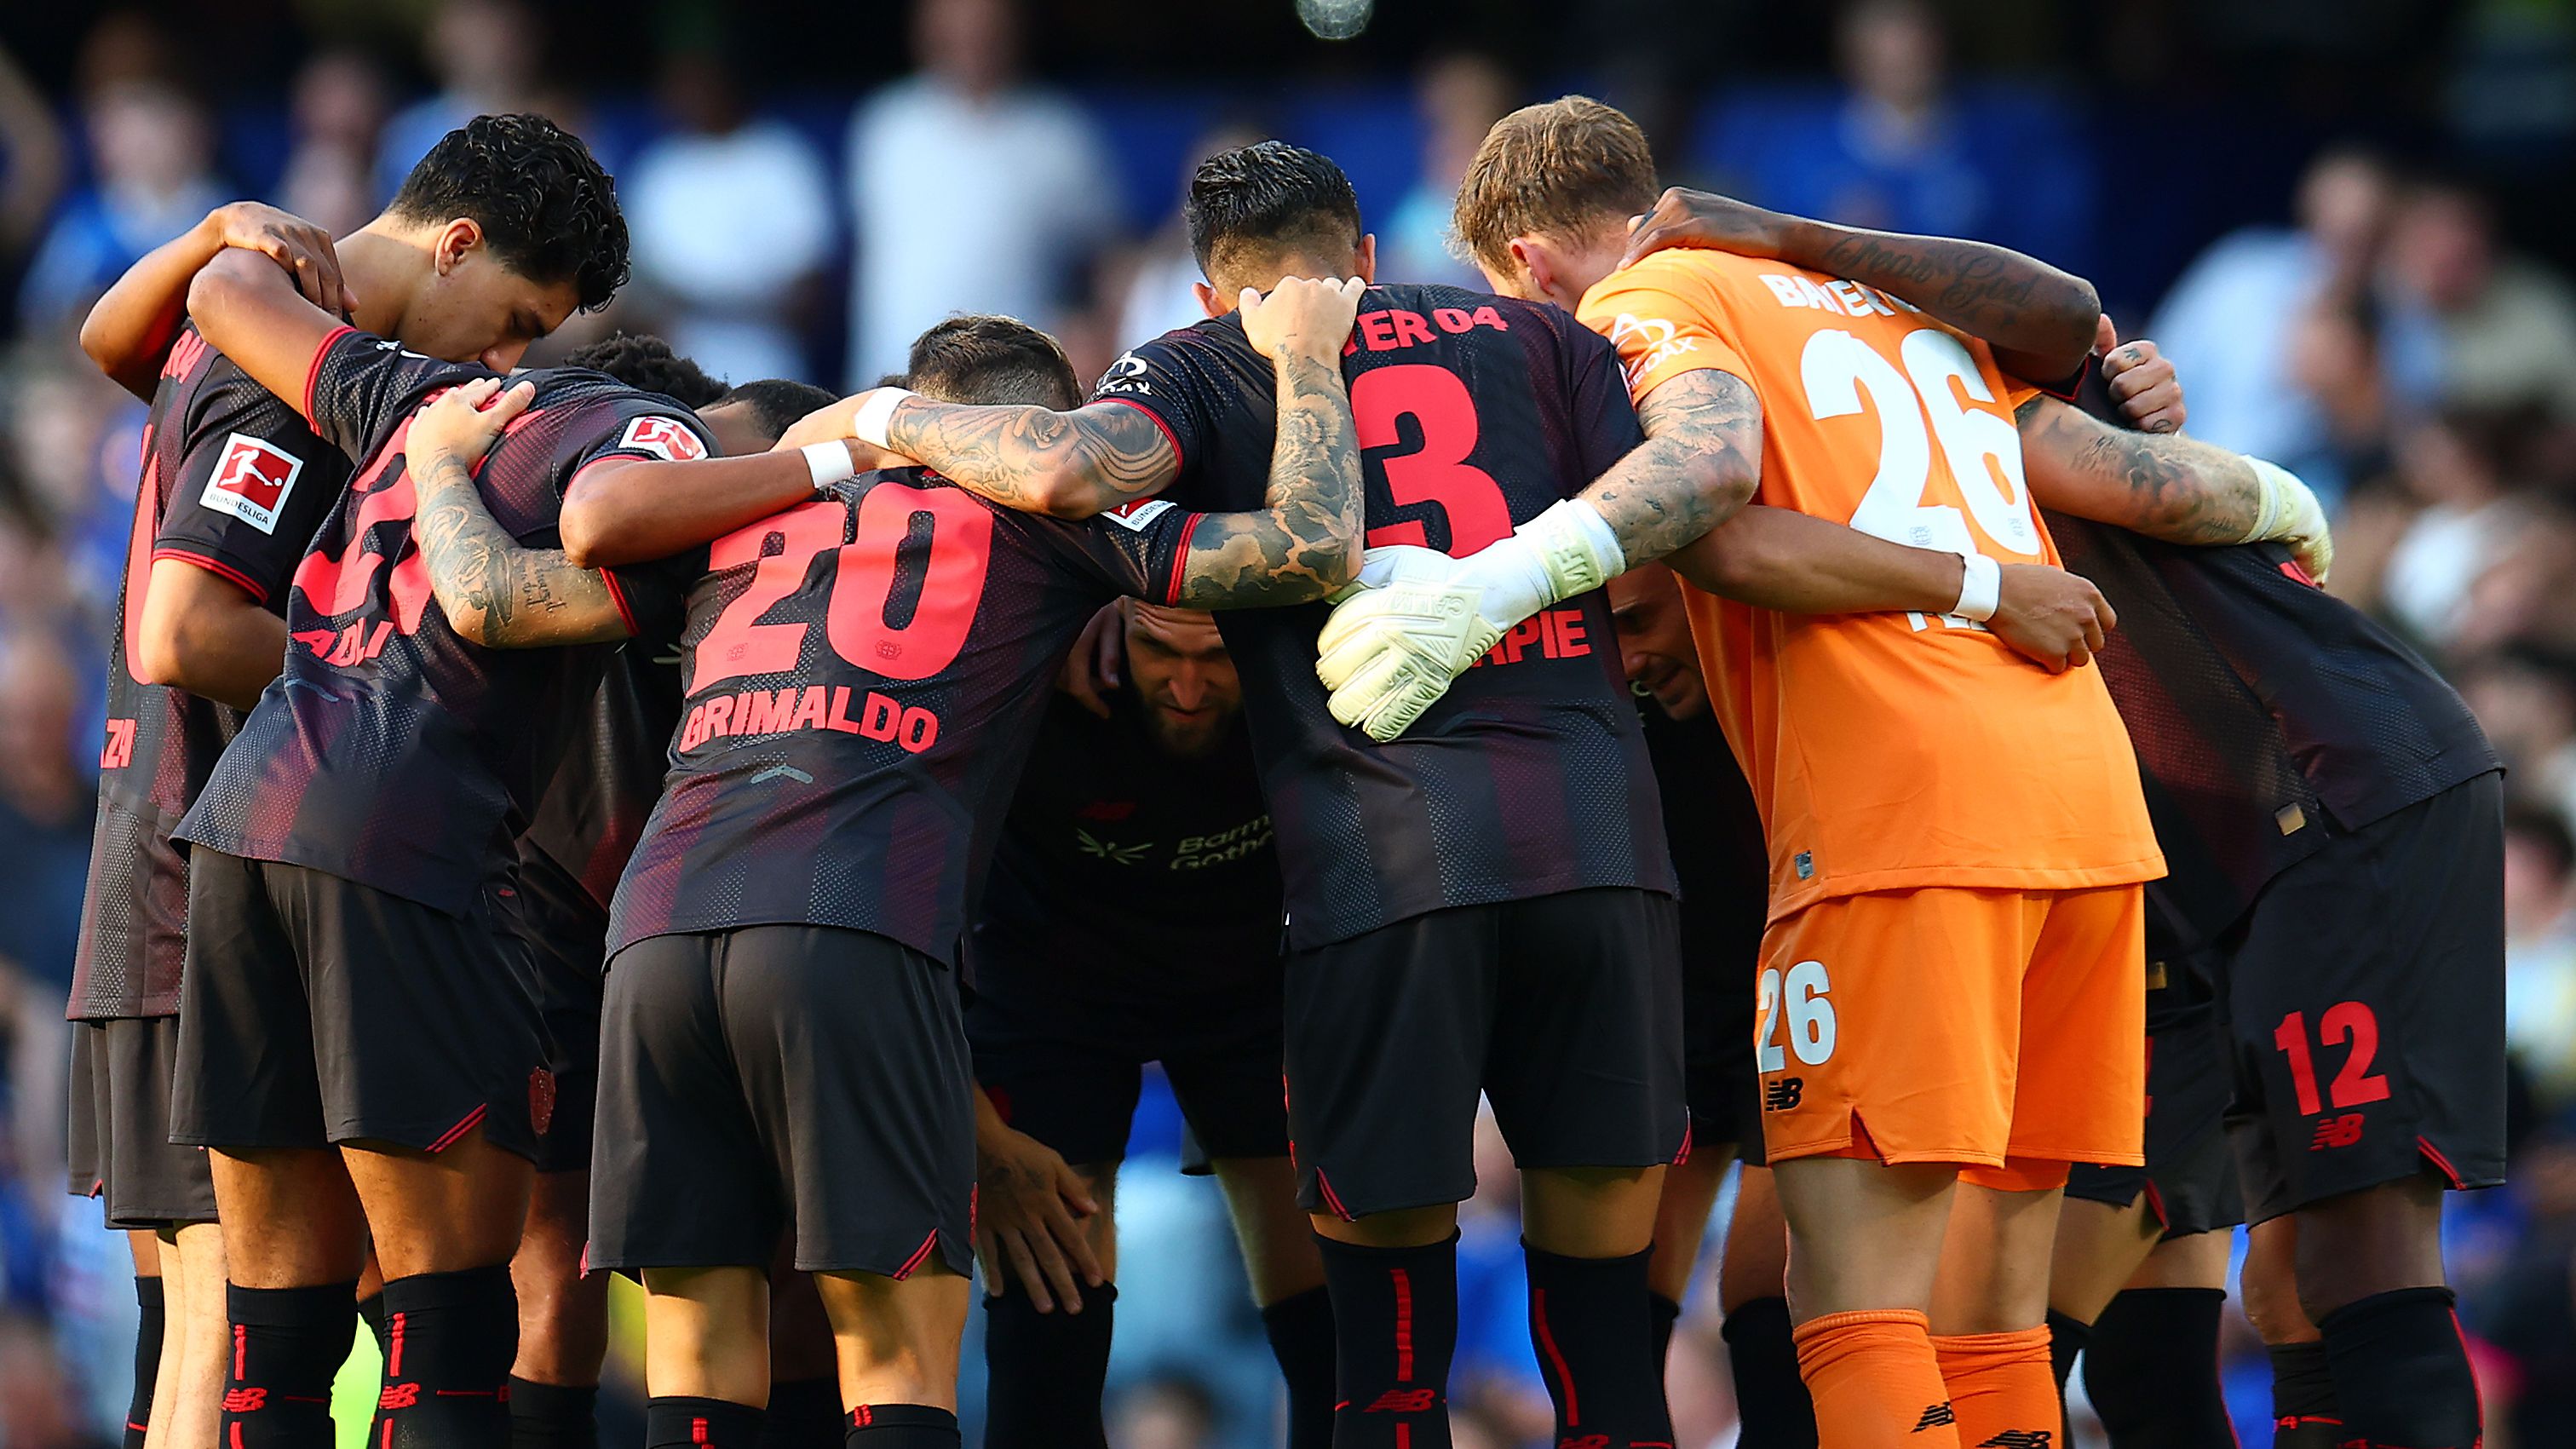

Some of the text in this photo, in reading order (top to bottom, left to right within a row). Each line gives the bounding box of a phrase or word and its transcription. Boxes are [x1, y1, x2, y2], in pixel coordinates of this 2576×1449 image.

[1343, 306, 1509, 357] ER 04
[1618, 336, 1699, 401] EDAX
[1351, 364, 1513, 561] 3
[1800, 328, 2041, 556] 26
[210, 494, 269, 525] BUNDESLIGA
[685, 481, 994, 699] 20
[100, 718, 135, 768] ZA
[679, 685, 940, 753] GRIMALDO
[1756, 960, 1837, 1074] 26
[2274, 1000, 2391, 1117] 12
